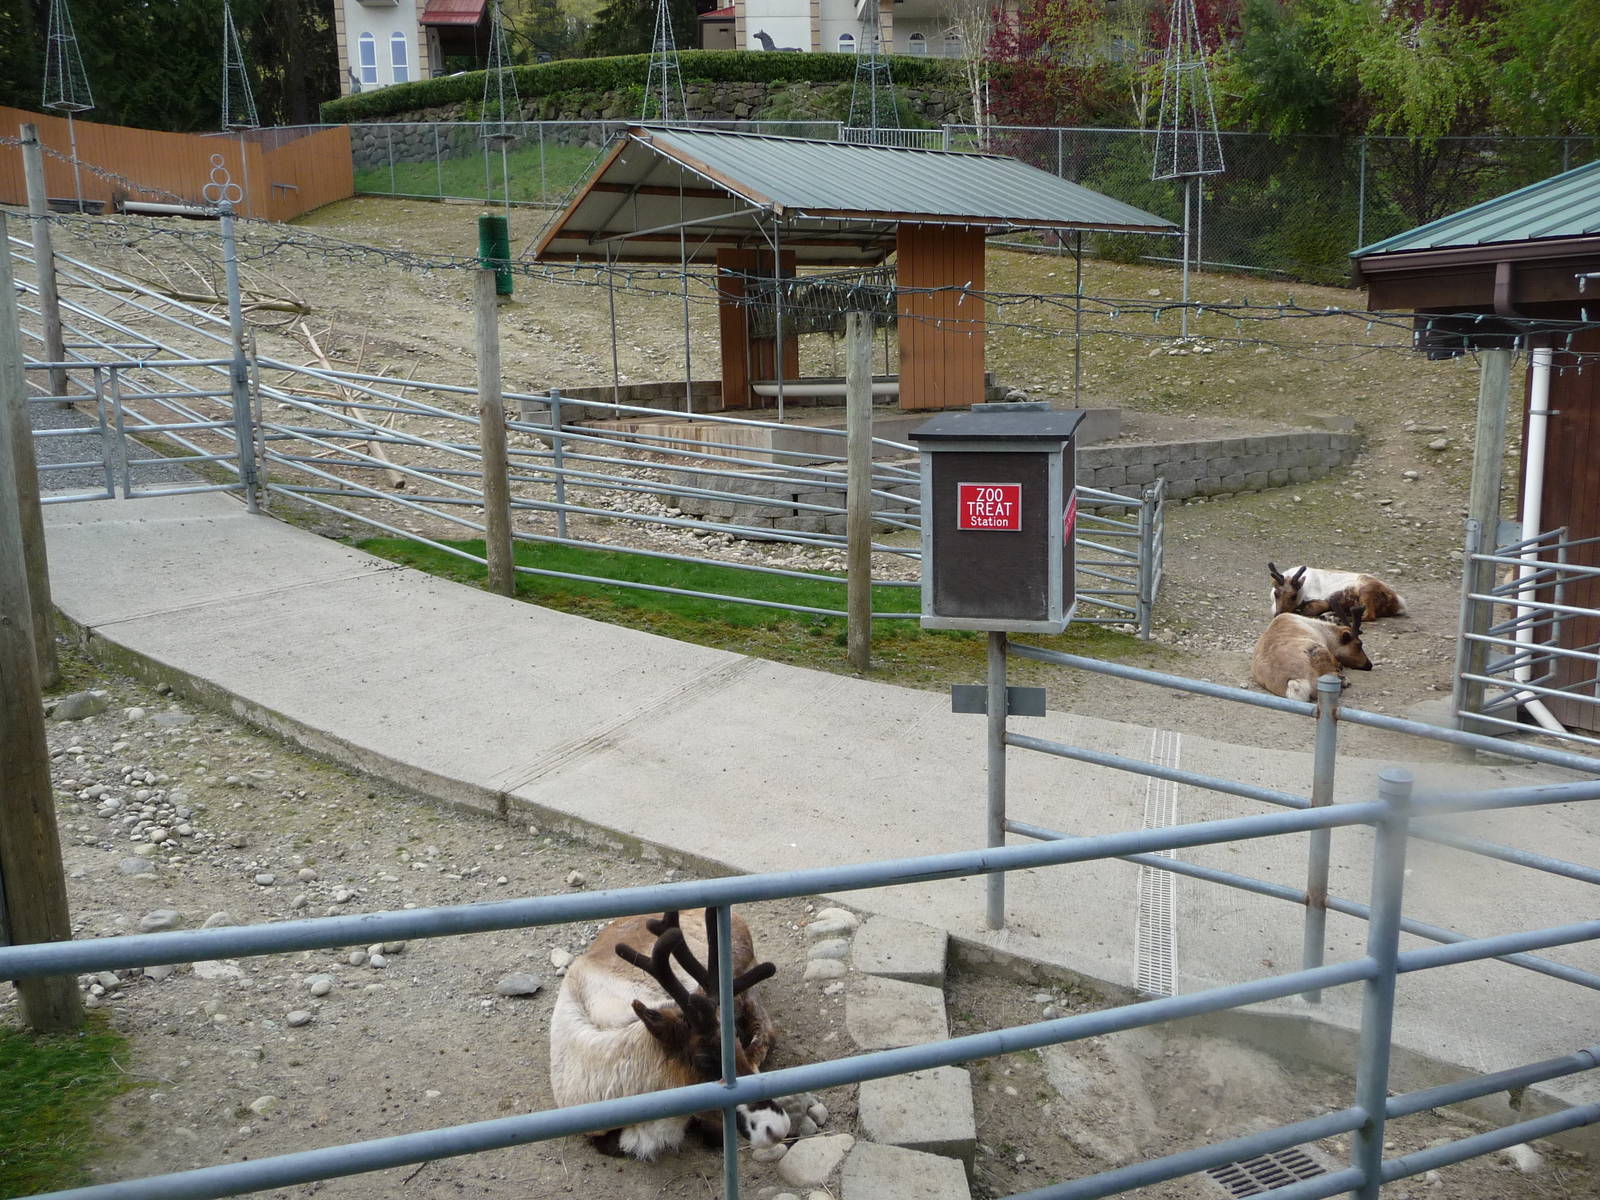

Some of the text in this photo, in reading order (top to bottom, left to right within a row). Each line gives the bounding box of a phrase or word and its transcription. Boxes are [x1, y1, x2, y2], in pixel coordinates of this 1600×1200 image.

[976, 488, 1003, 502] ZOO
[967, 502, 1013, 516] TREAT
[970, 516, 1009, 527] Station
